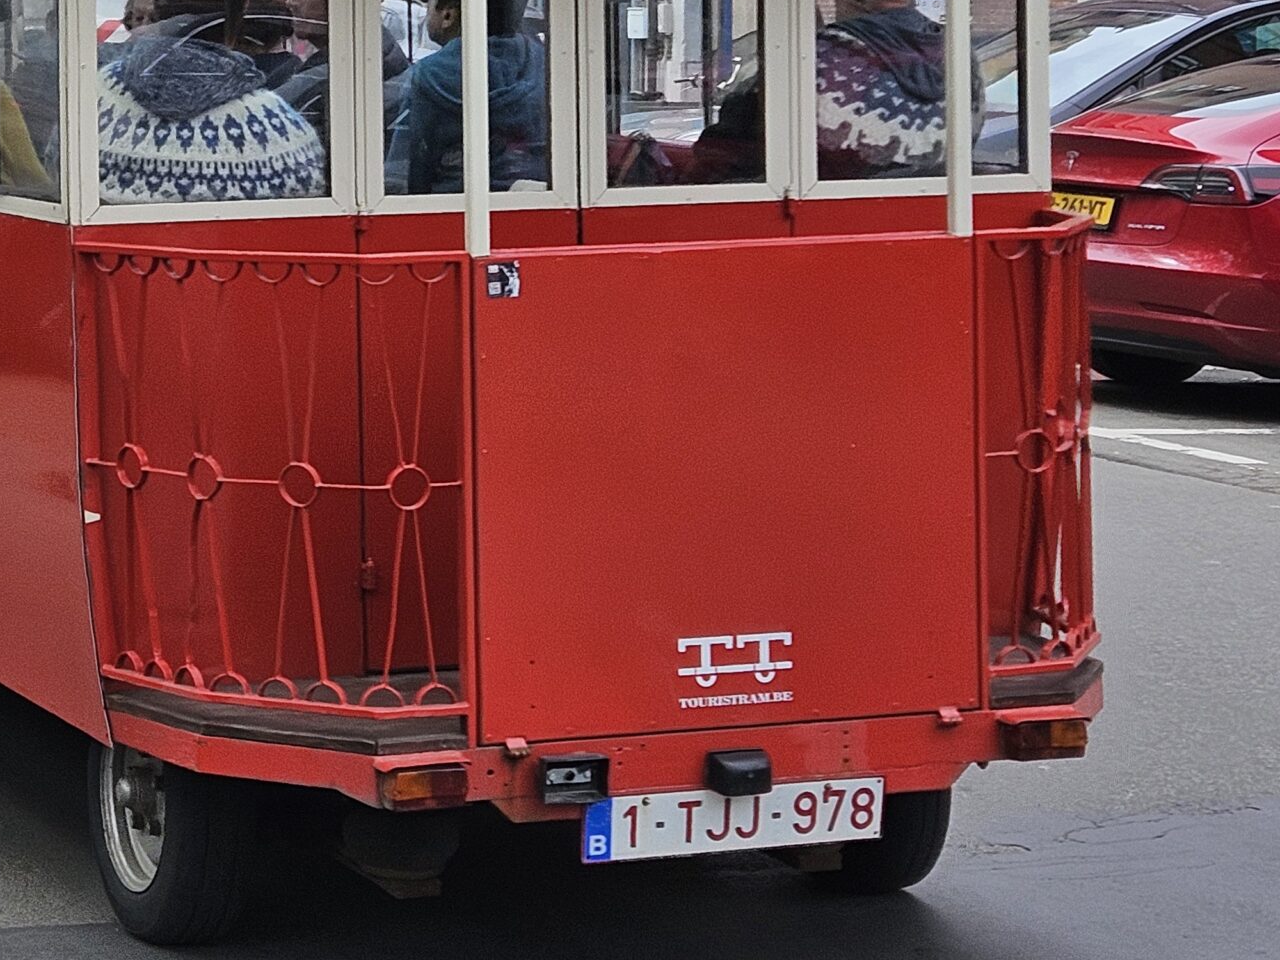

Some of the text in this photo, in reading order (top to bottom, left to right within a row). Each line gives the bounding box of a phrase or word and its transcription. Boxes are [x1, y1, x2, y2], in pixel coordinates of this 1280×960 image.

[678, 690, 794, 709] TOURISTRAM.BE
[622, 786, 876, 849] 1-TJJ-978
[588, 834, 608, 857] B
